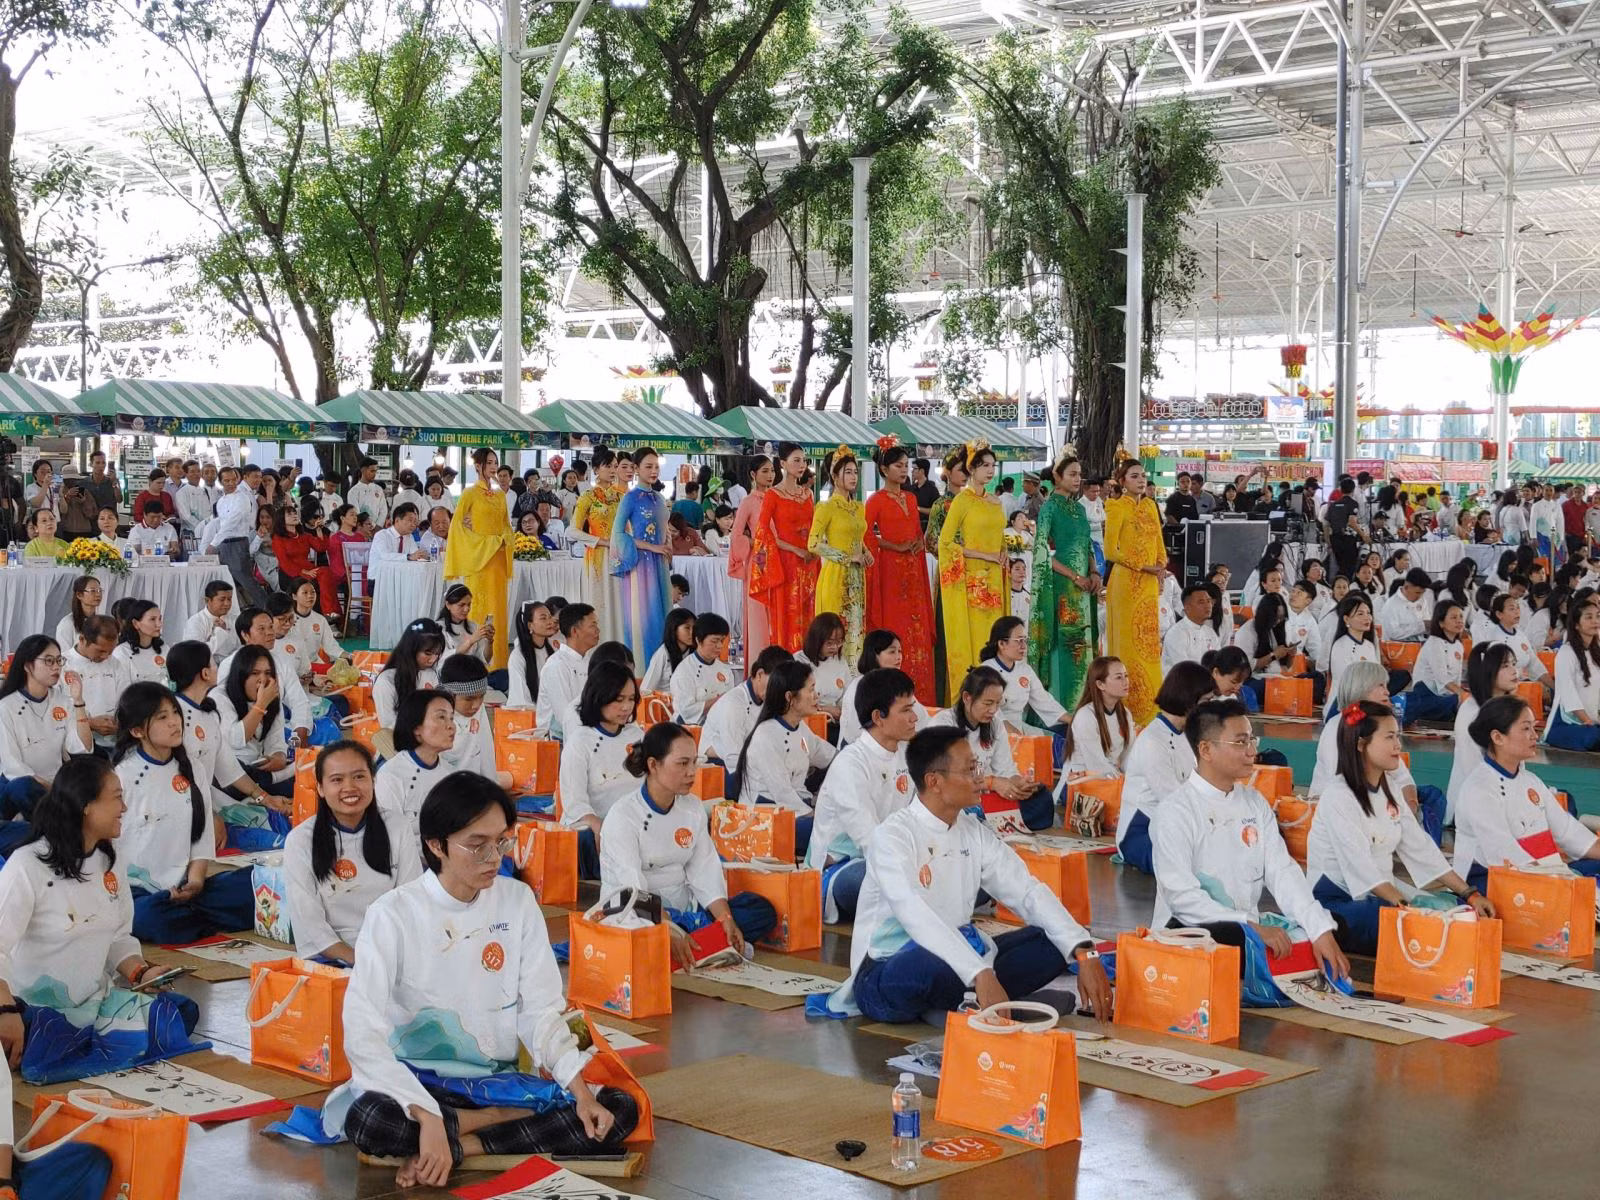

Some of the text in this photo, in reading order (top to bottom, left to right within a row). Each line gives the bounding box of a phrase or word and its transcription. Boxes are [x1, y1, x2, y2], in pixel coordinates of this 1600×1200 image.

[206, 424, 225, 434] TIEN
[226, 425, 255, 435] THEME
[256, 426, 279, 436] PARK
[457, 434, 482, 444] THEME
[483, 435, 503, 444] PARK
[672, 440, 691, 450] PARK
[485, 951, 501, 967] 517
[932, 1138, 984, 1156] 518
